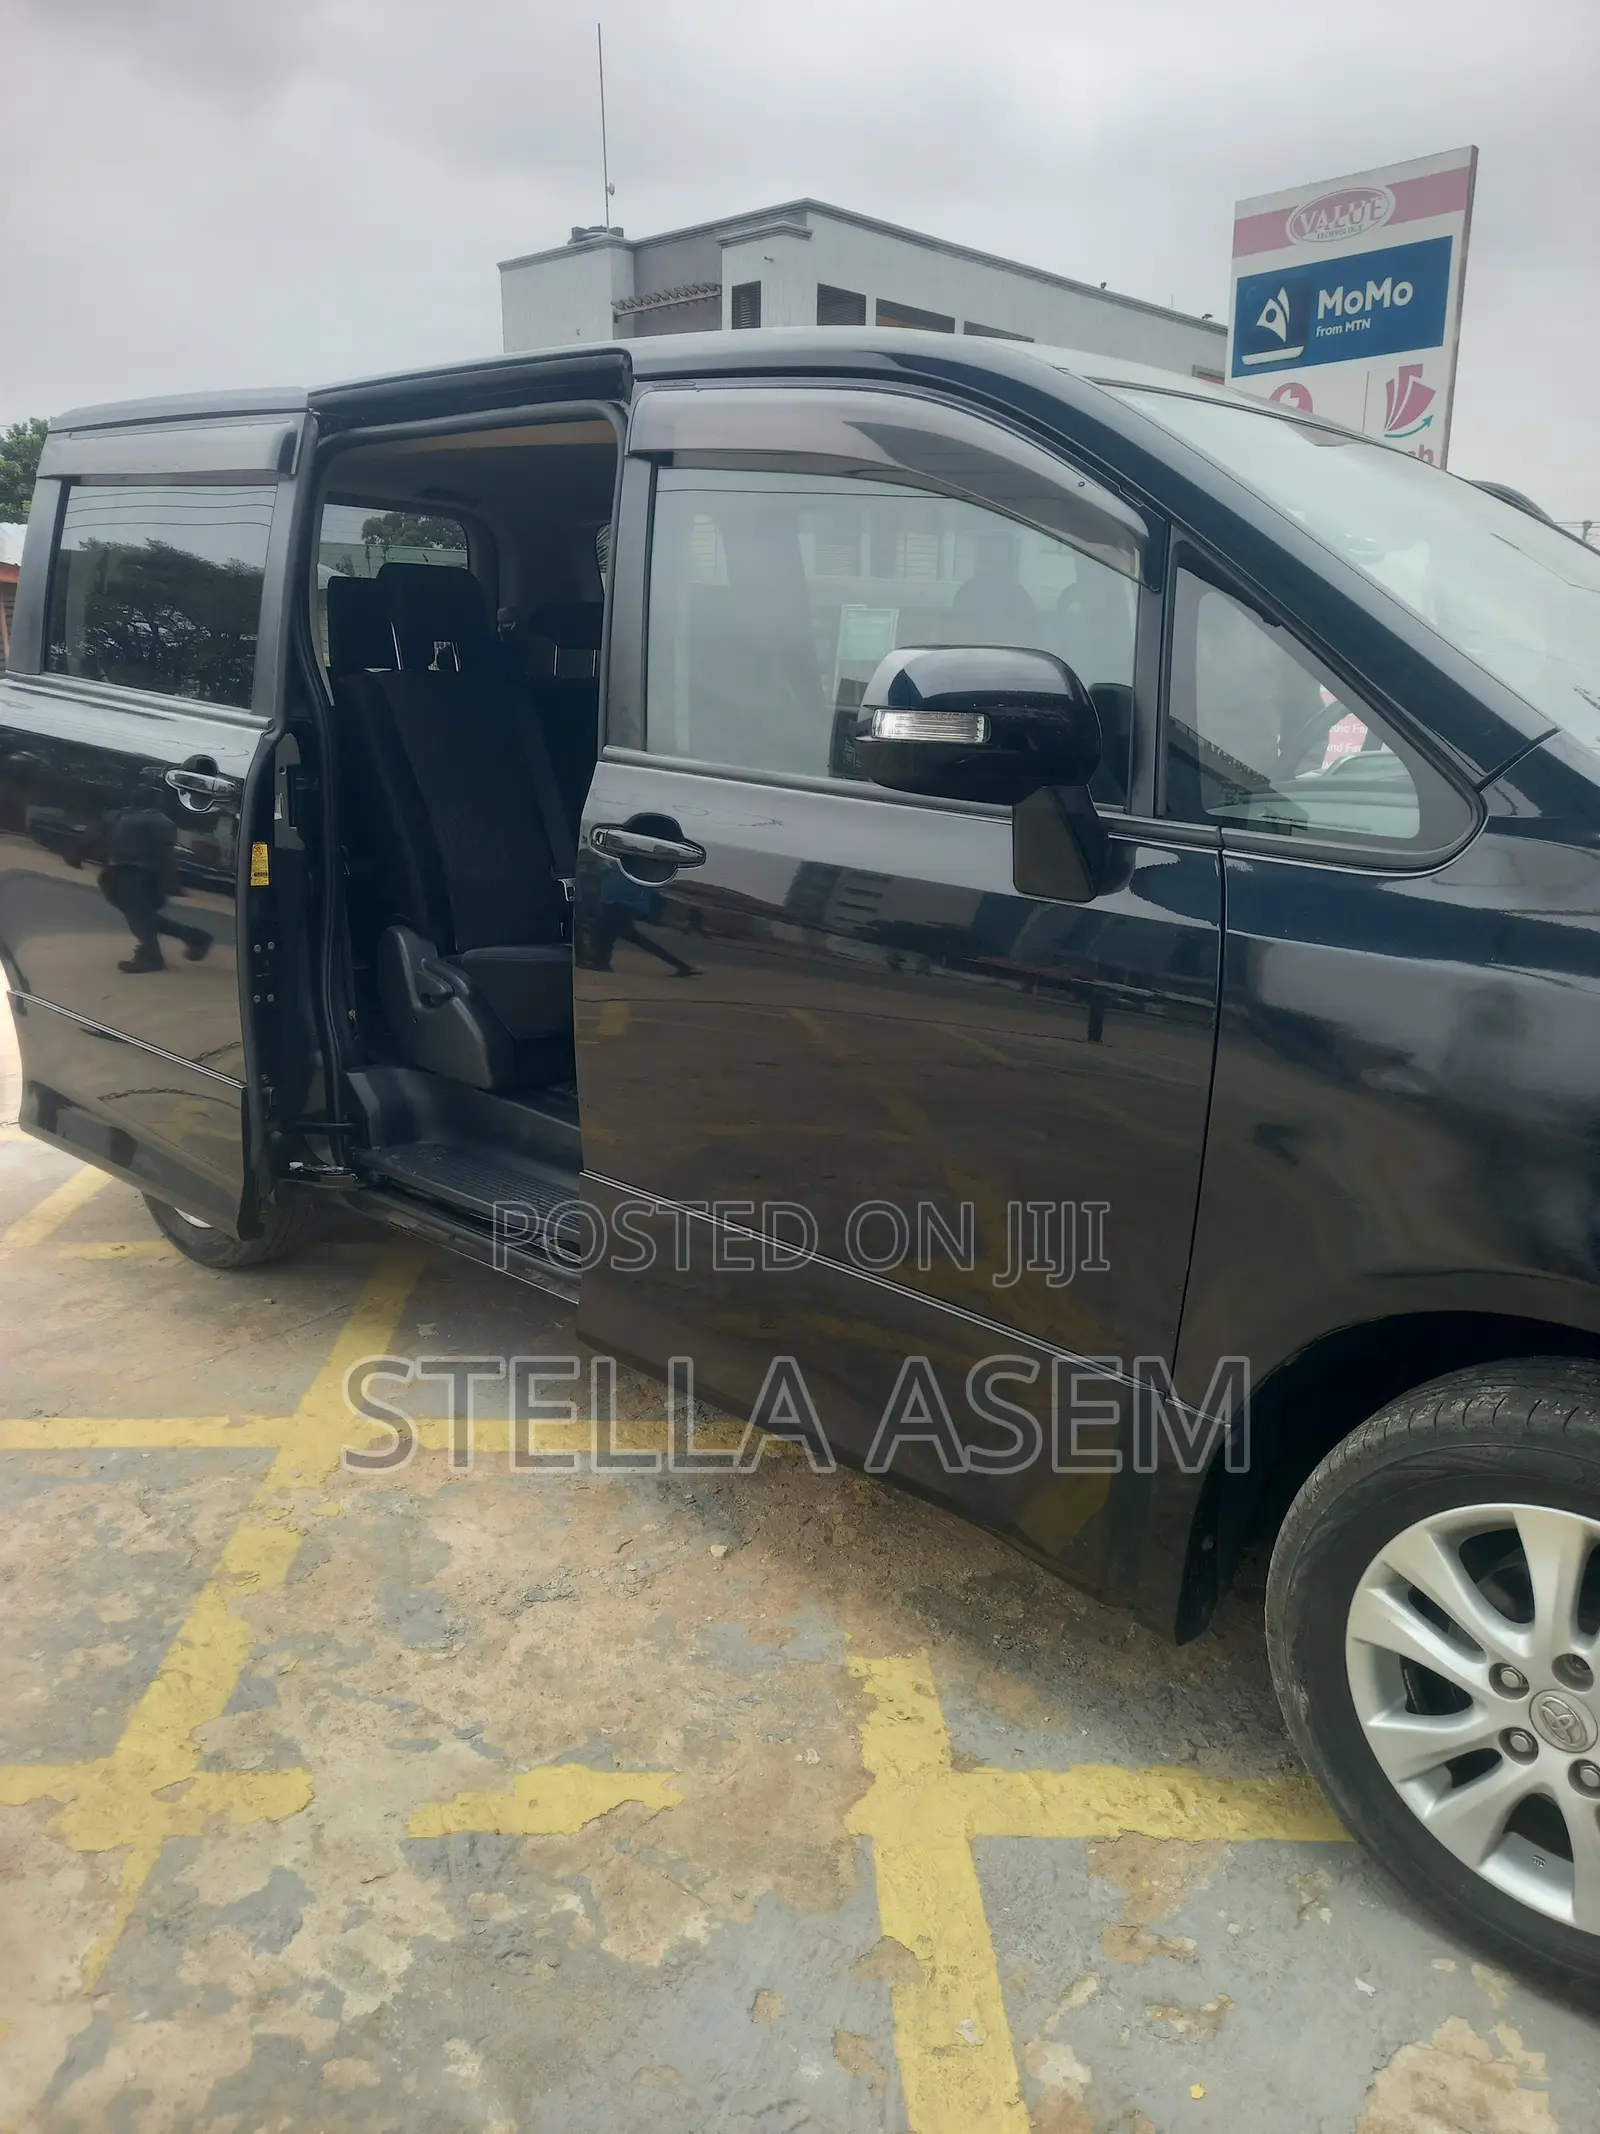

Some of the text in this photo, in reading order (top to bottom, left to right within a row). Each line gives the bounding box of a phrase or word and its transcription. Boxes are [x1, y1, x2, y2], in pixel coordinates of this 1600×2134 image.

[1300, 196, 1383, 237] VALUE
[1317, 277, 1414, 320] MoMo
[1315, 318, 1372, 338] from MTN
